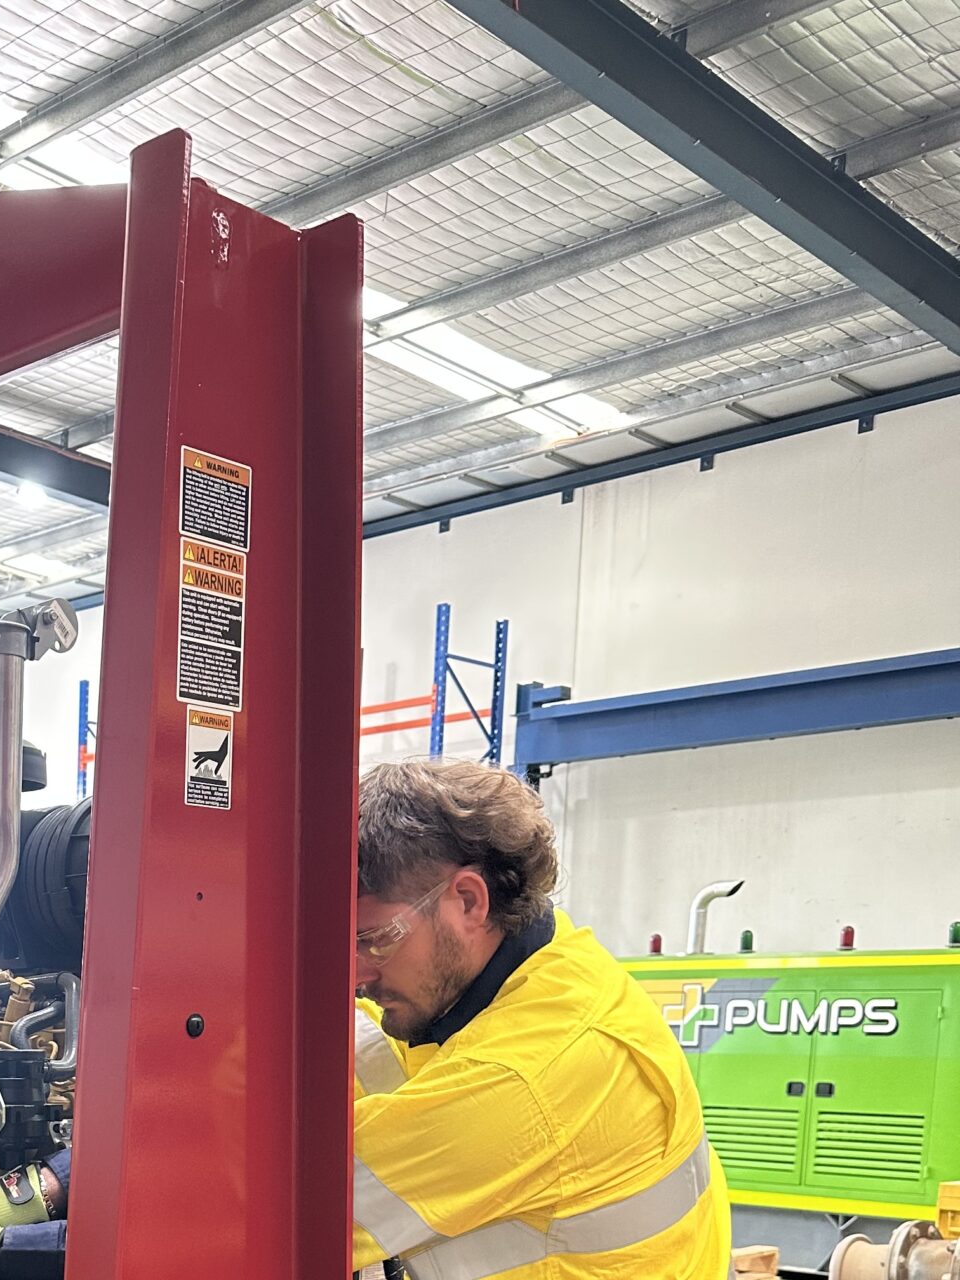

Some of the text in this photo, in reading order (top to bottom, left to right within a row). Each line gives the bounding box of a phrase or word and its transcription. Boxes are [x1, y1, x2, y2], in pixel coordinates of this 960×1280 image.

[205, 461, 239, 478] WARNING
[195, 569, 242, 595] WARNING
[200, 715, 229, 727] WARNING
[724, 998, 898, 1035] PUMPS
